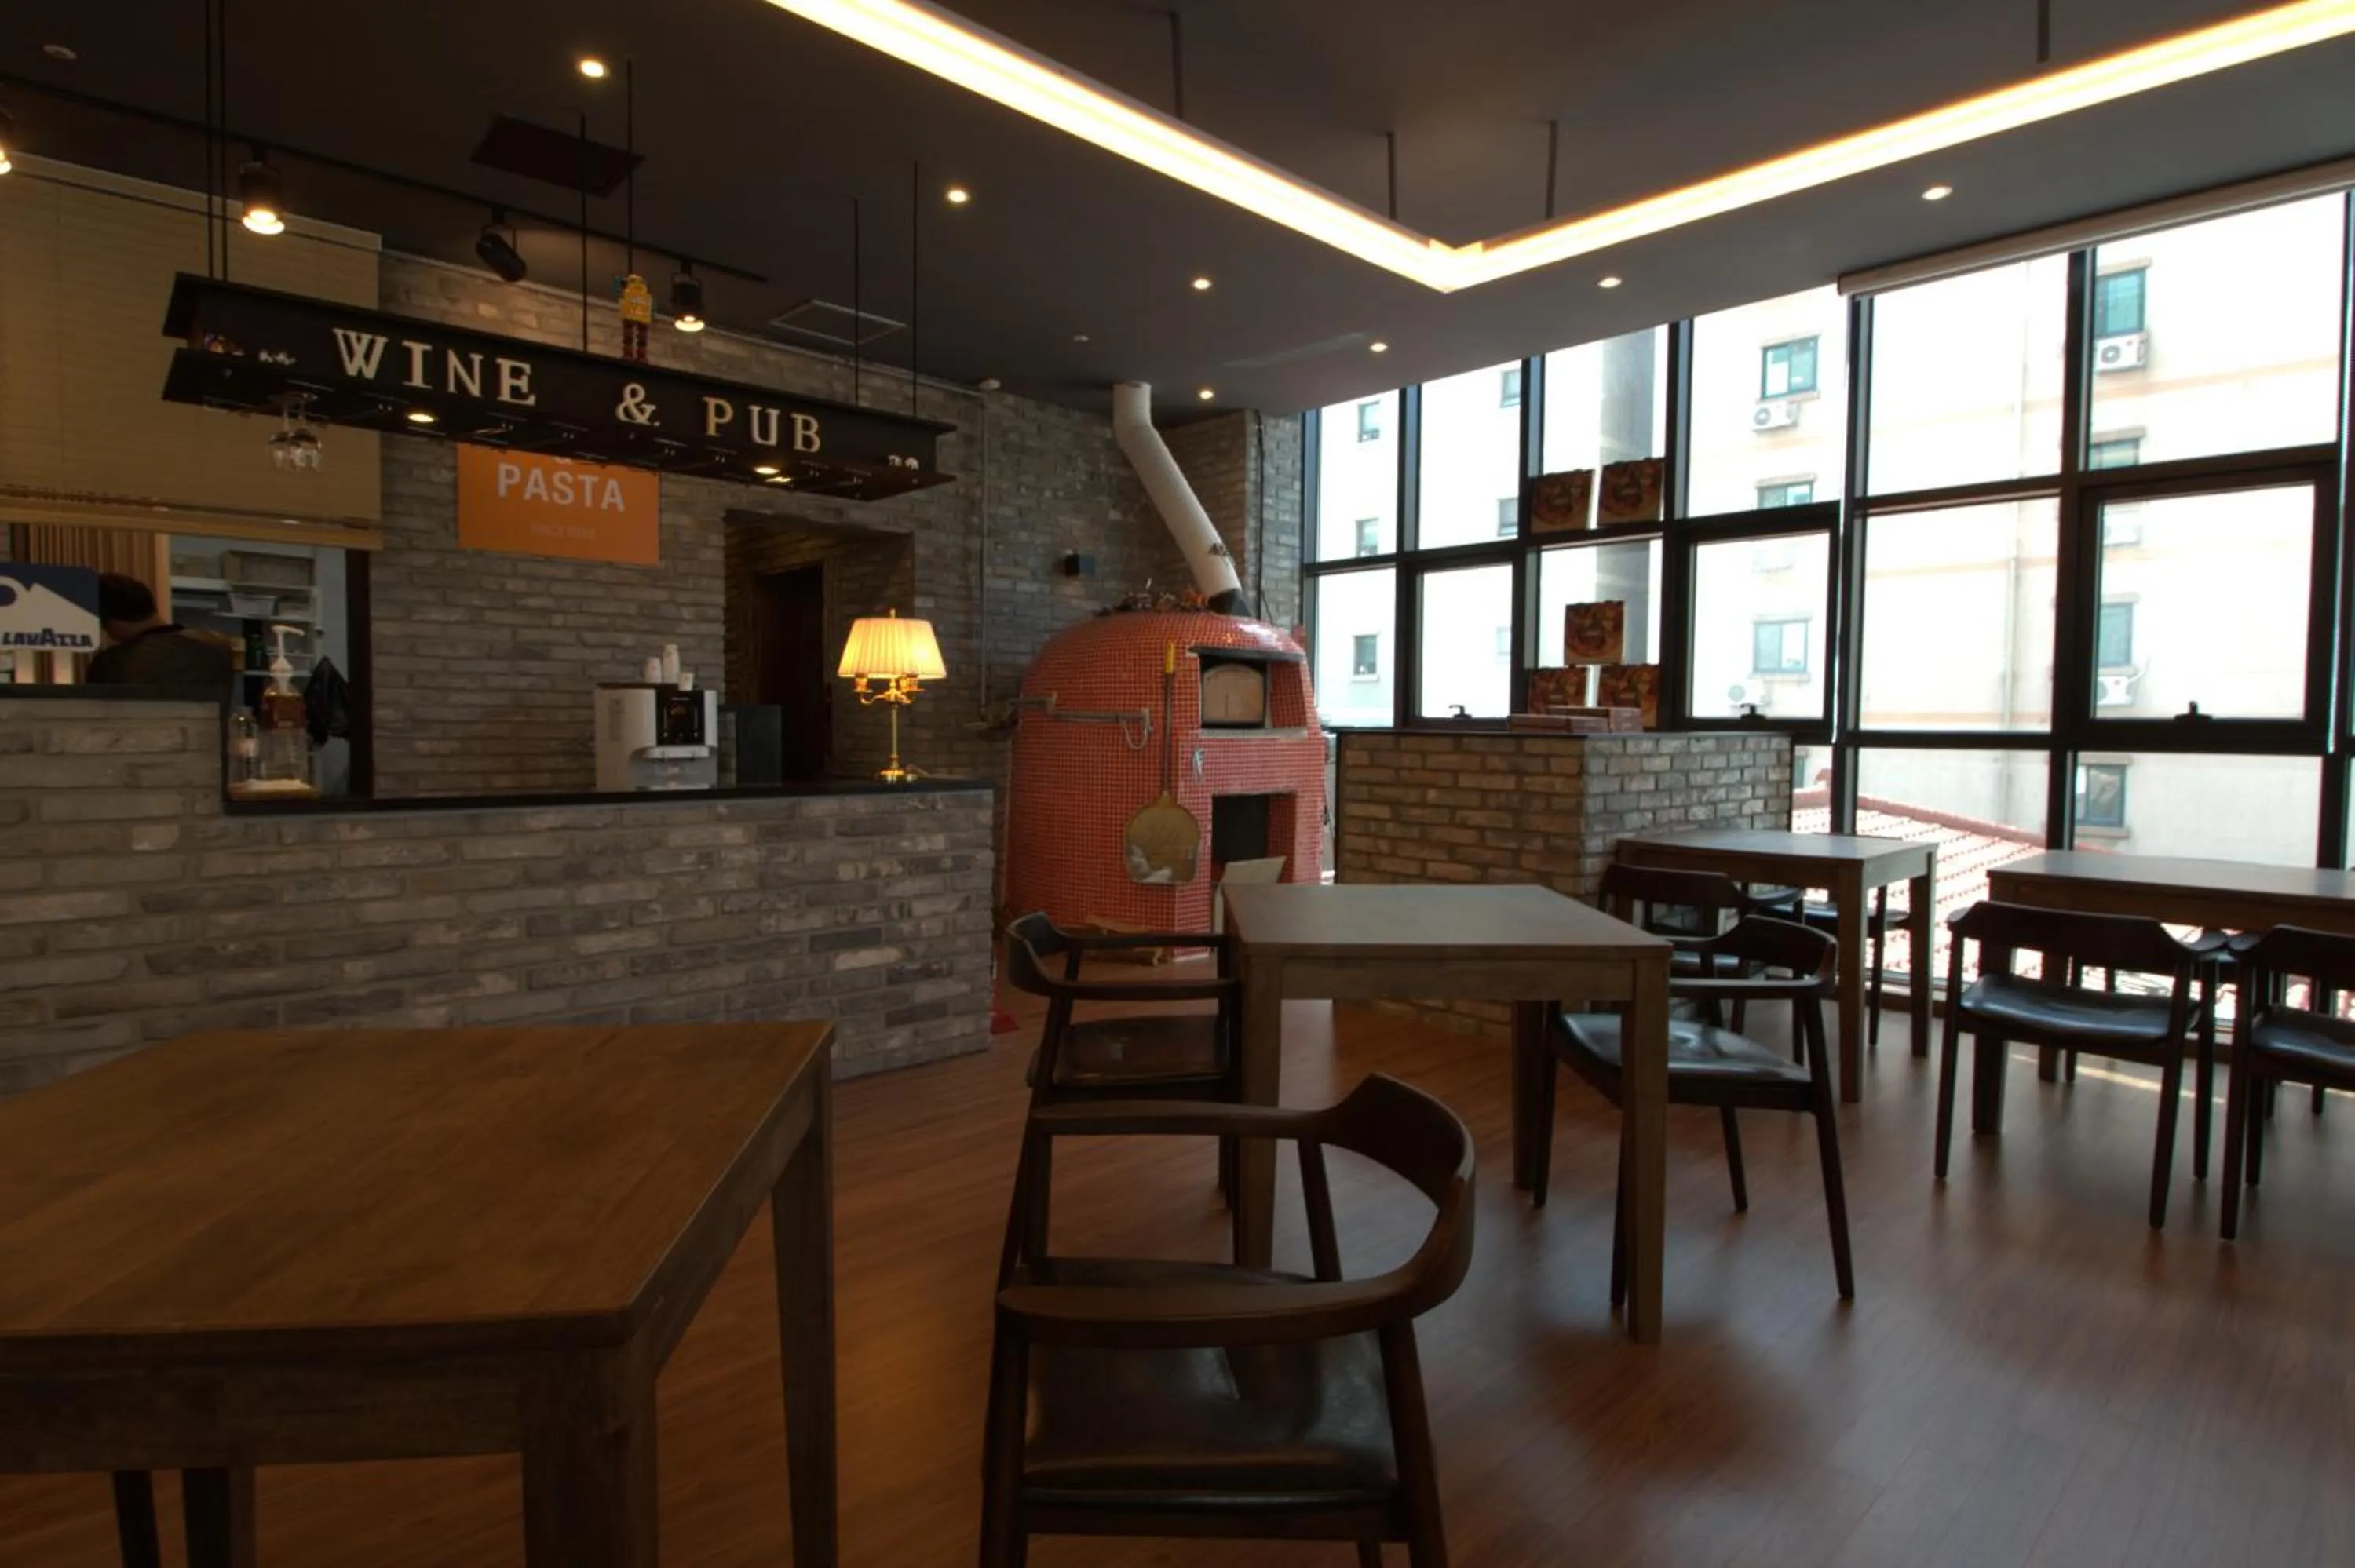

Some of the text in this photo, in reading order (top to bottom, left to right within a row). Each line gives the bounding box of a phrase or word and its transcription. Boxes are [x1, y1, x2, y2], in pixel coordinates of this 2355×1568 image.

[333, 327, 821, 454] WINE & PUB
[496, 461, 626, 512] PASTA
